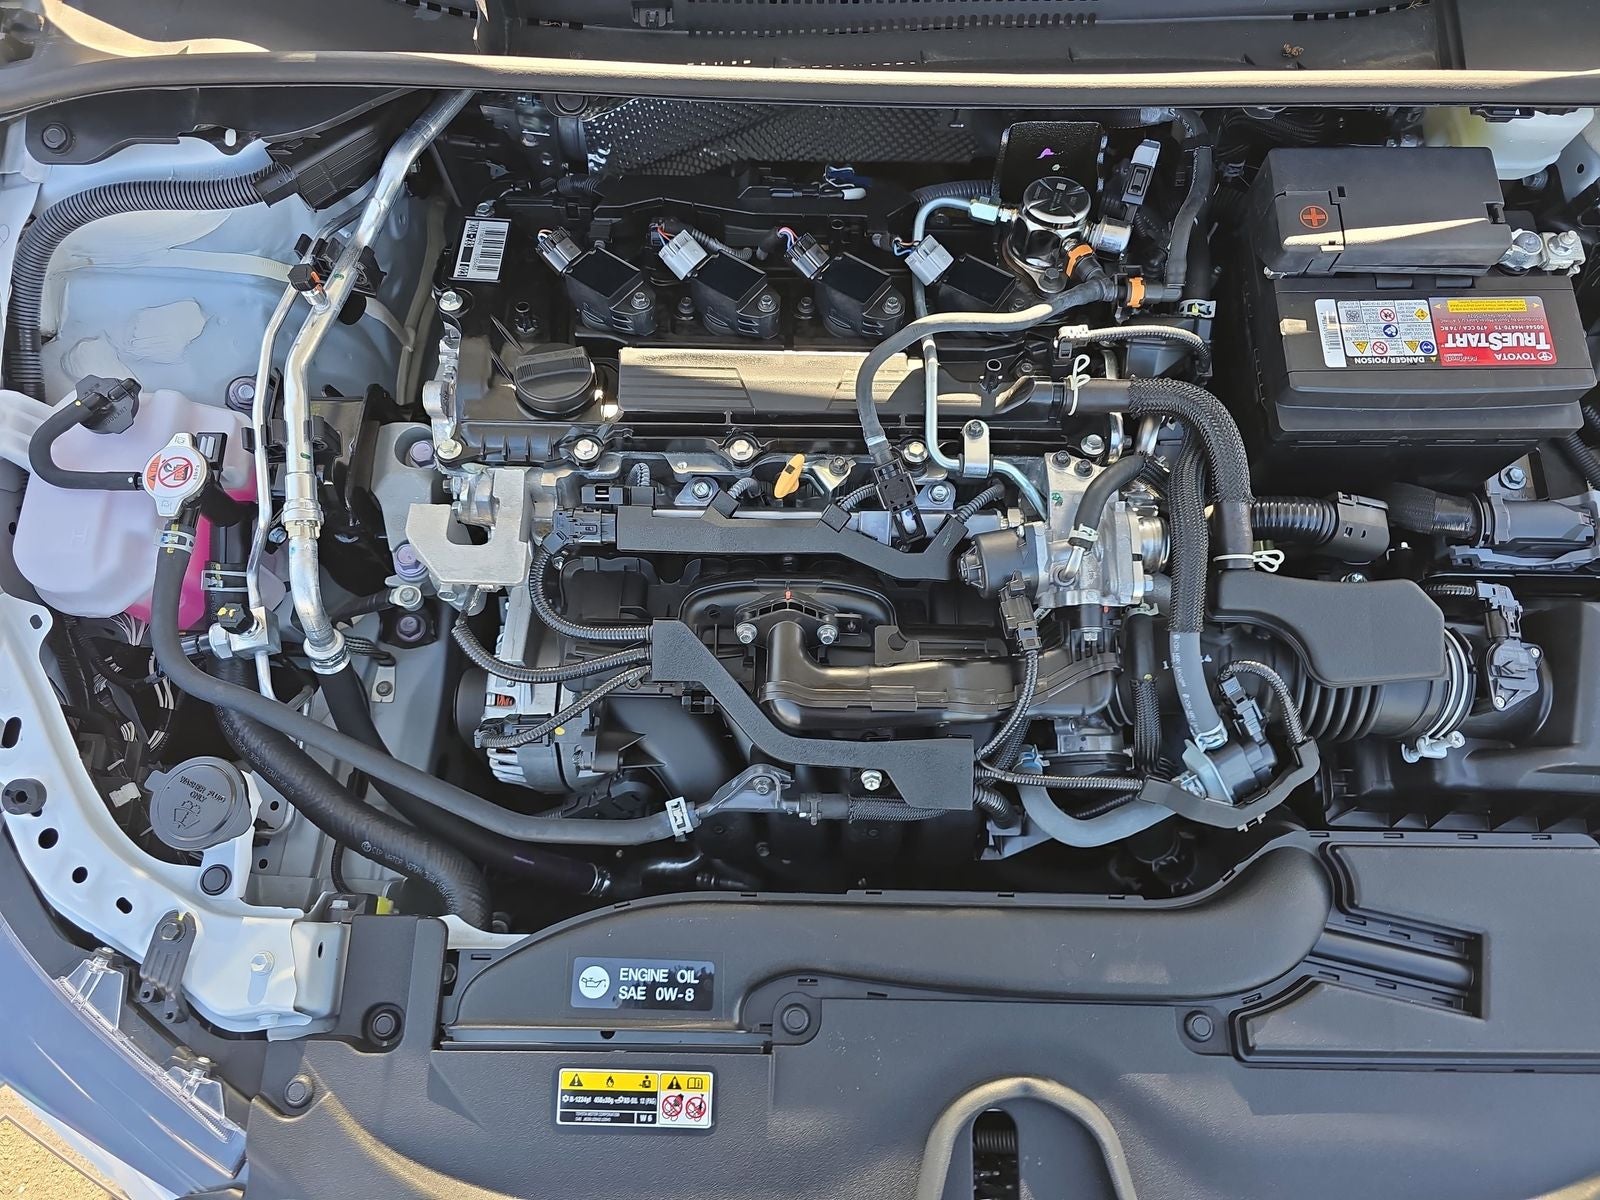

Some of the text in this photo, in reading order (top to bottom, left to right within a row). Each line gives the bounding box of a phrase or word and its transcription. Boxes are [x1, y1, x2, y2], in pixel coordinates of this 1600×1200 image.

[1354, 356, 1425, 364] DANGER/POISON
[1494, 353, 1536, 361] TOYOTA
[180, 775, 206, 793] WASHER
[190, 791, 207, 803] ONLY
[619, 967, 699, 984] ENGINE OIL
[618, 985, 695, 1002] SAE 0W-8
